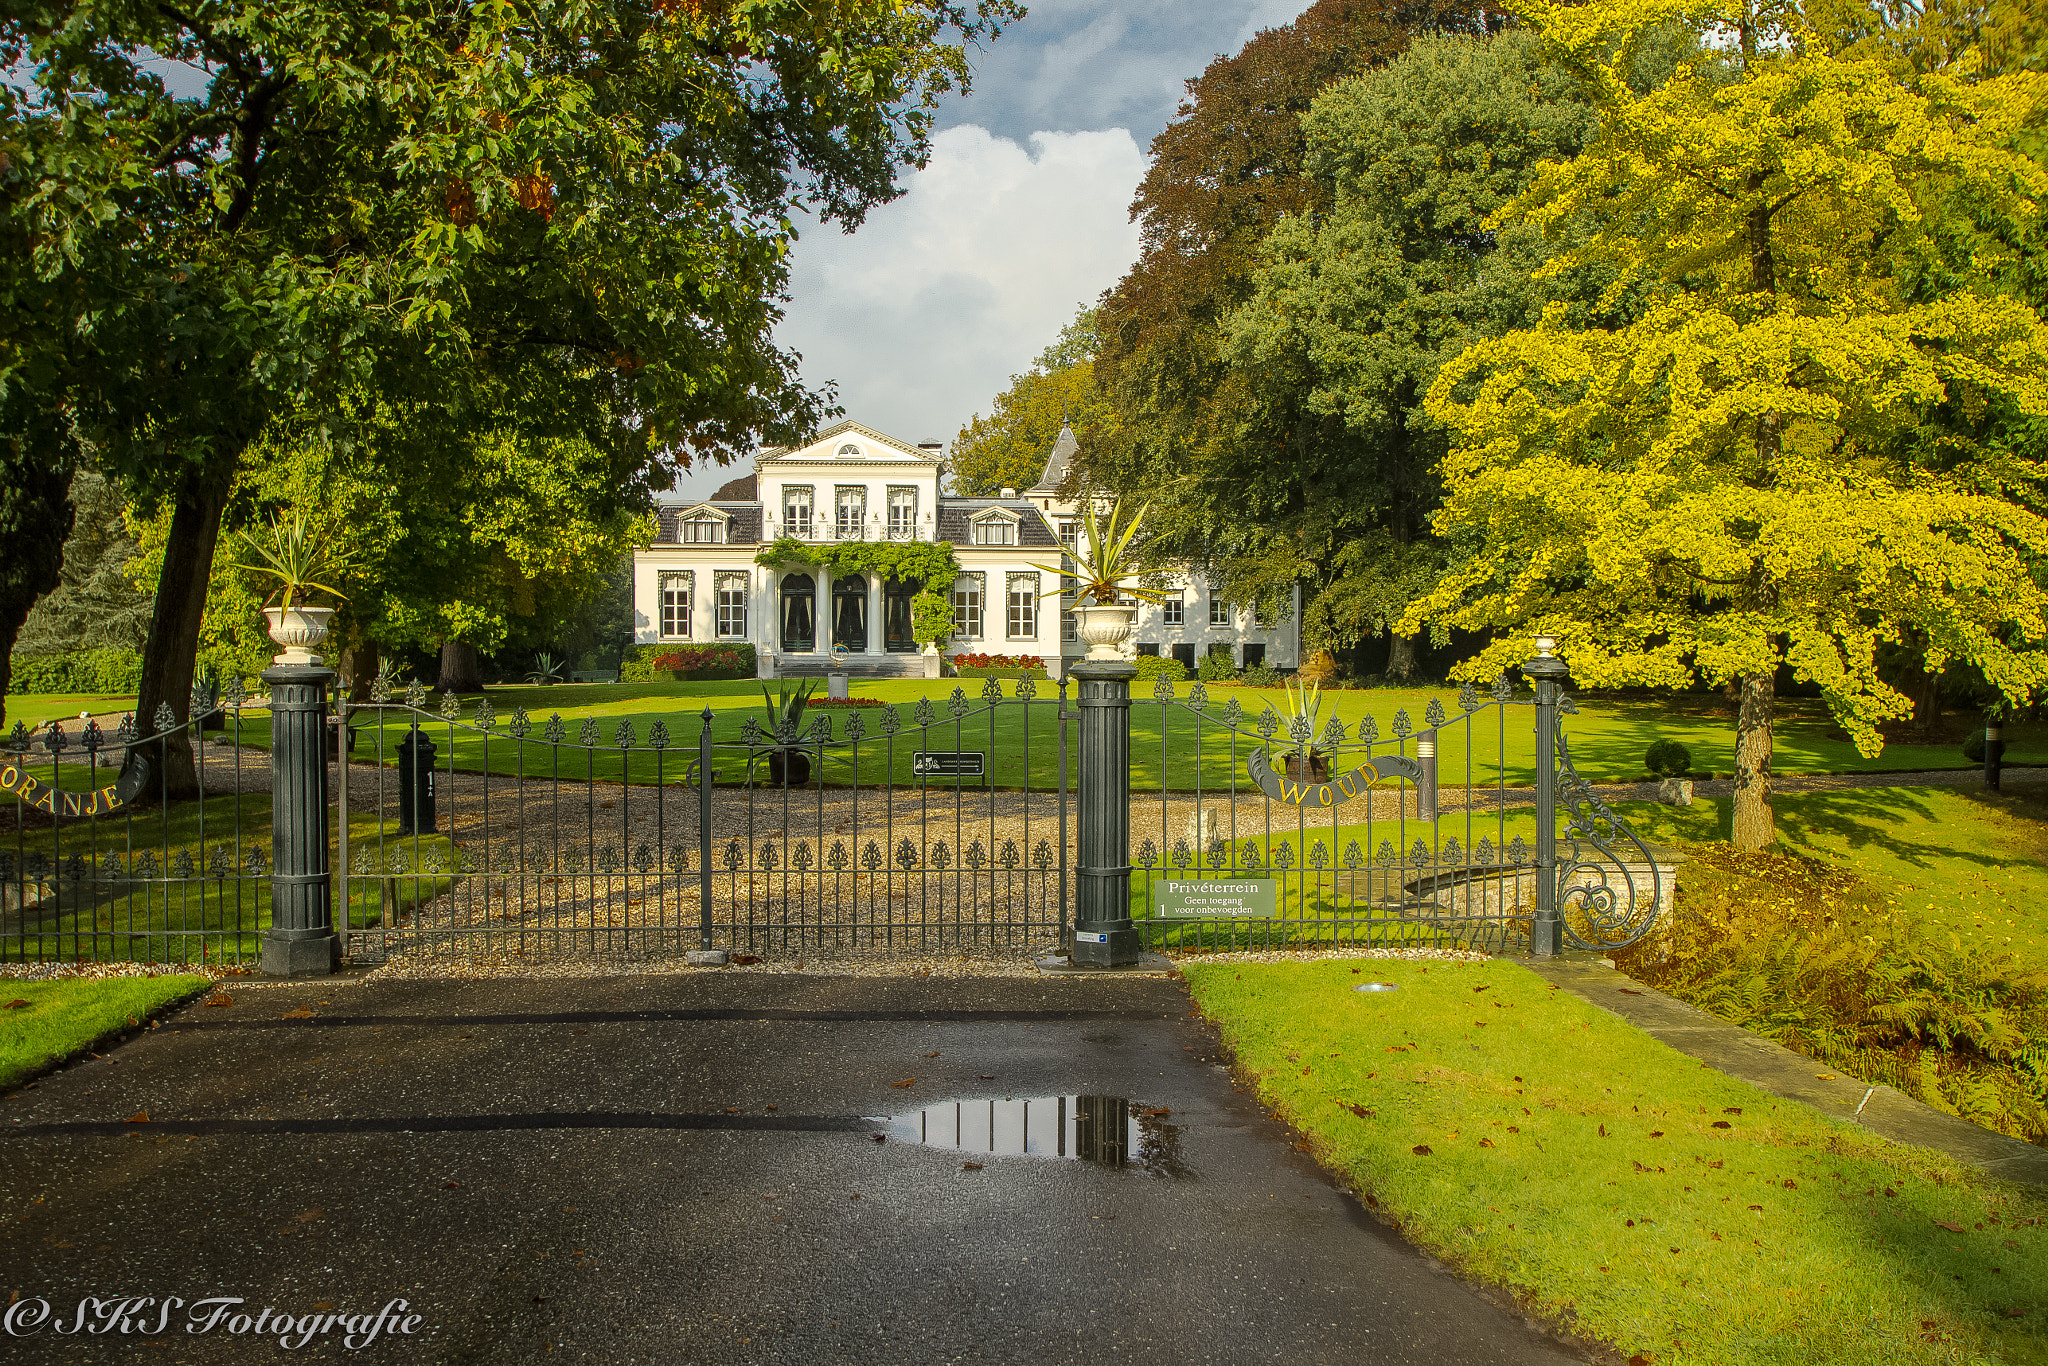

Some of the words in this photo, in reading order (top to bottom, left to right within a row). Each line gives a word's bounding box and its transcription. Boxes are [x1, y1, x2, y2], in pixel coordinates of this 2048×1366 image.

[1277, 762, 1379, 806] WOUD
[0, 766, 124, 816] ORANJE
[1168, 882, 1259, 893] Privéterrein
[1184, 897, 1207, 905] Geen
[1209, 897, 1243, 906] toegang
[1160, 904, 1166, 917] 1
[1196, 906, 1253, 915] onbevoegden
